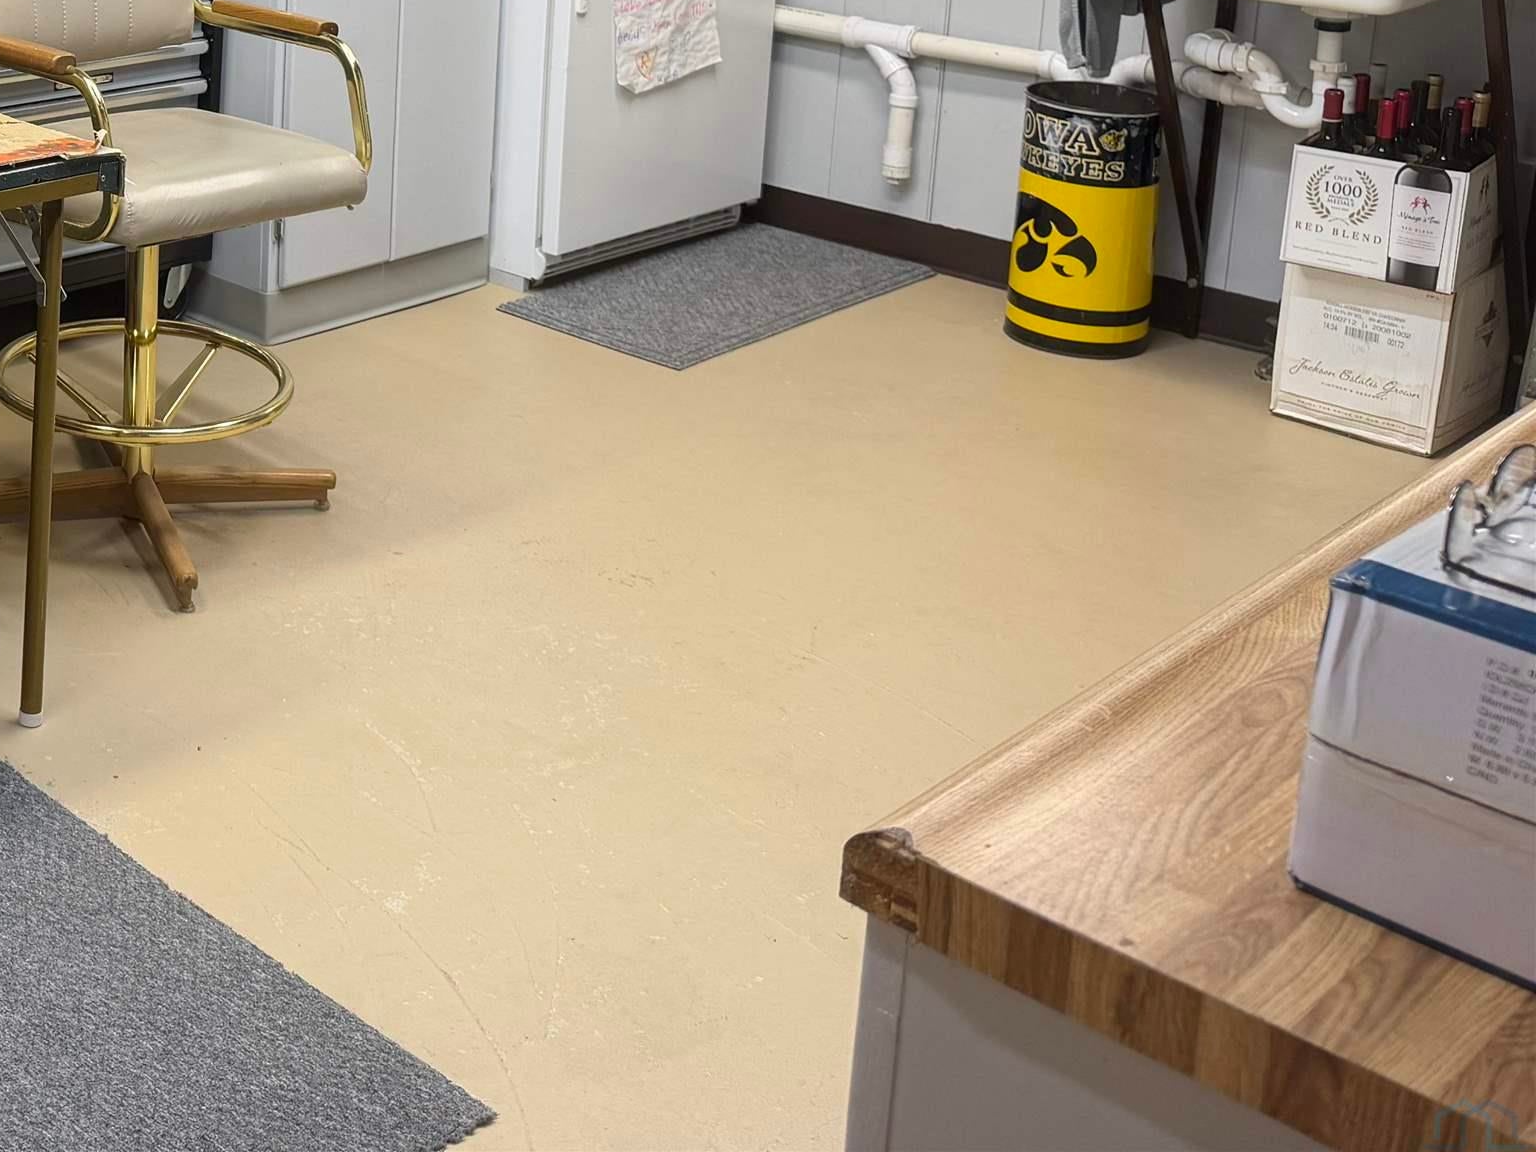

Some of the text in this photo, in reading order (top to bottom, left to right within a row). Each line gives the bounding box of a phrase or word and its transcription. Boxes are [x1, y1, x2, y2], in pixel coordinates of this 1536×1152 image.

[1023, 107, 1101, 156] OWA
[1022, 143, 1125, 182] KEYES
[1333, 174, 1353, 183] OVER
[1324, 181, 1362, 198] 1000
[1295, 220, 1382, 245] RED BLEND
[1289, 357, 1420, 399] Jackson Estates Grown
